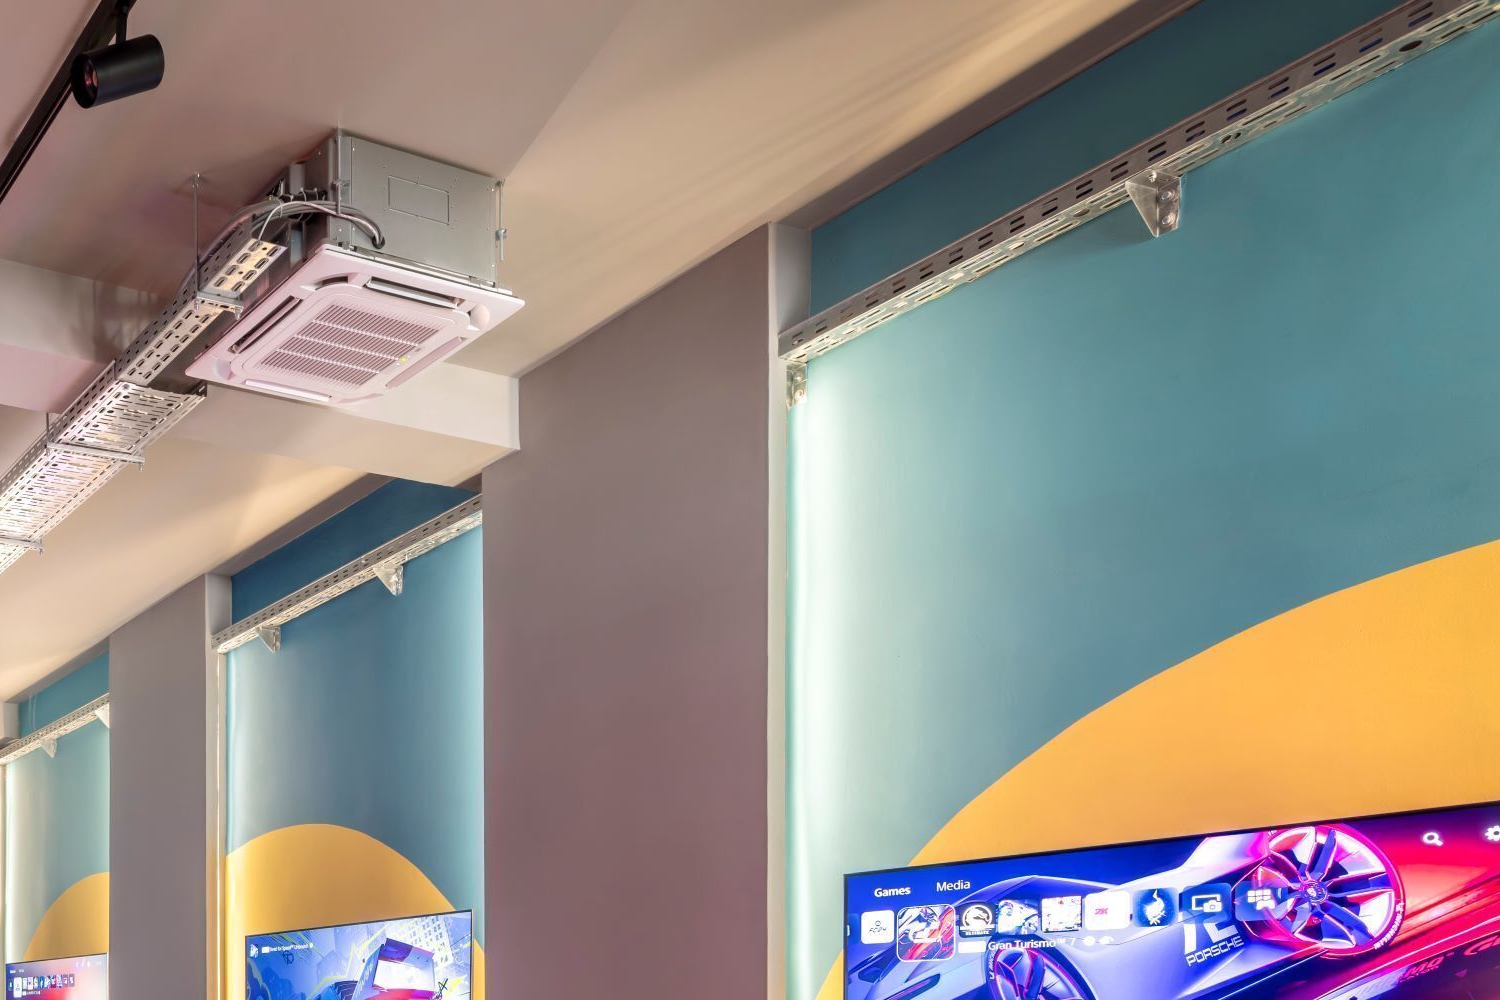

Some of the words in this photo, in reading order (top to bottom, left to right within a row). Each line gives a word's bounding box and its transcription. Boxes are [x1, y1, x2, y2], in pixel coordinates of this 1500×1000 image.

[874, 887, 911, 898] Games
[936, 880, 971, 892] Media
[988, 940, 1012, 951] Gran
[1070, 937, 1076, 946] 7
[1185, 935, 1245, 967] PORSCHE
